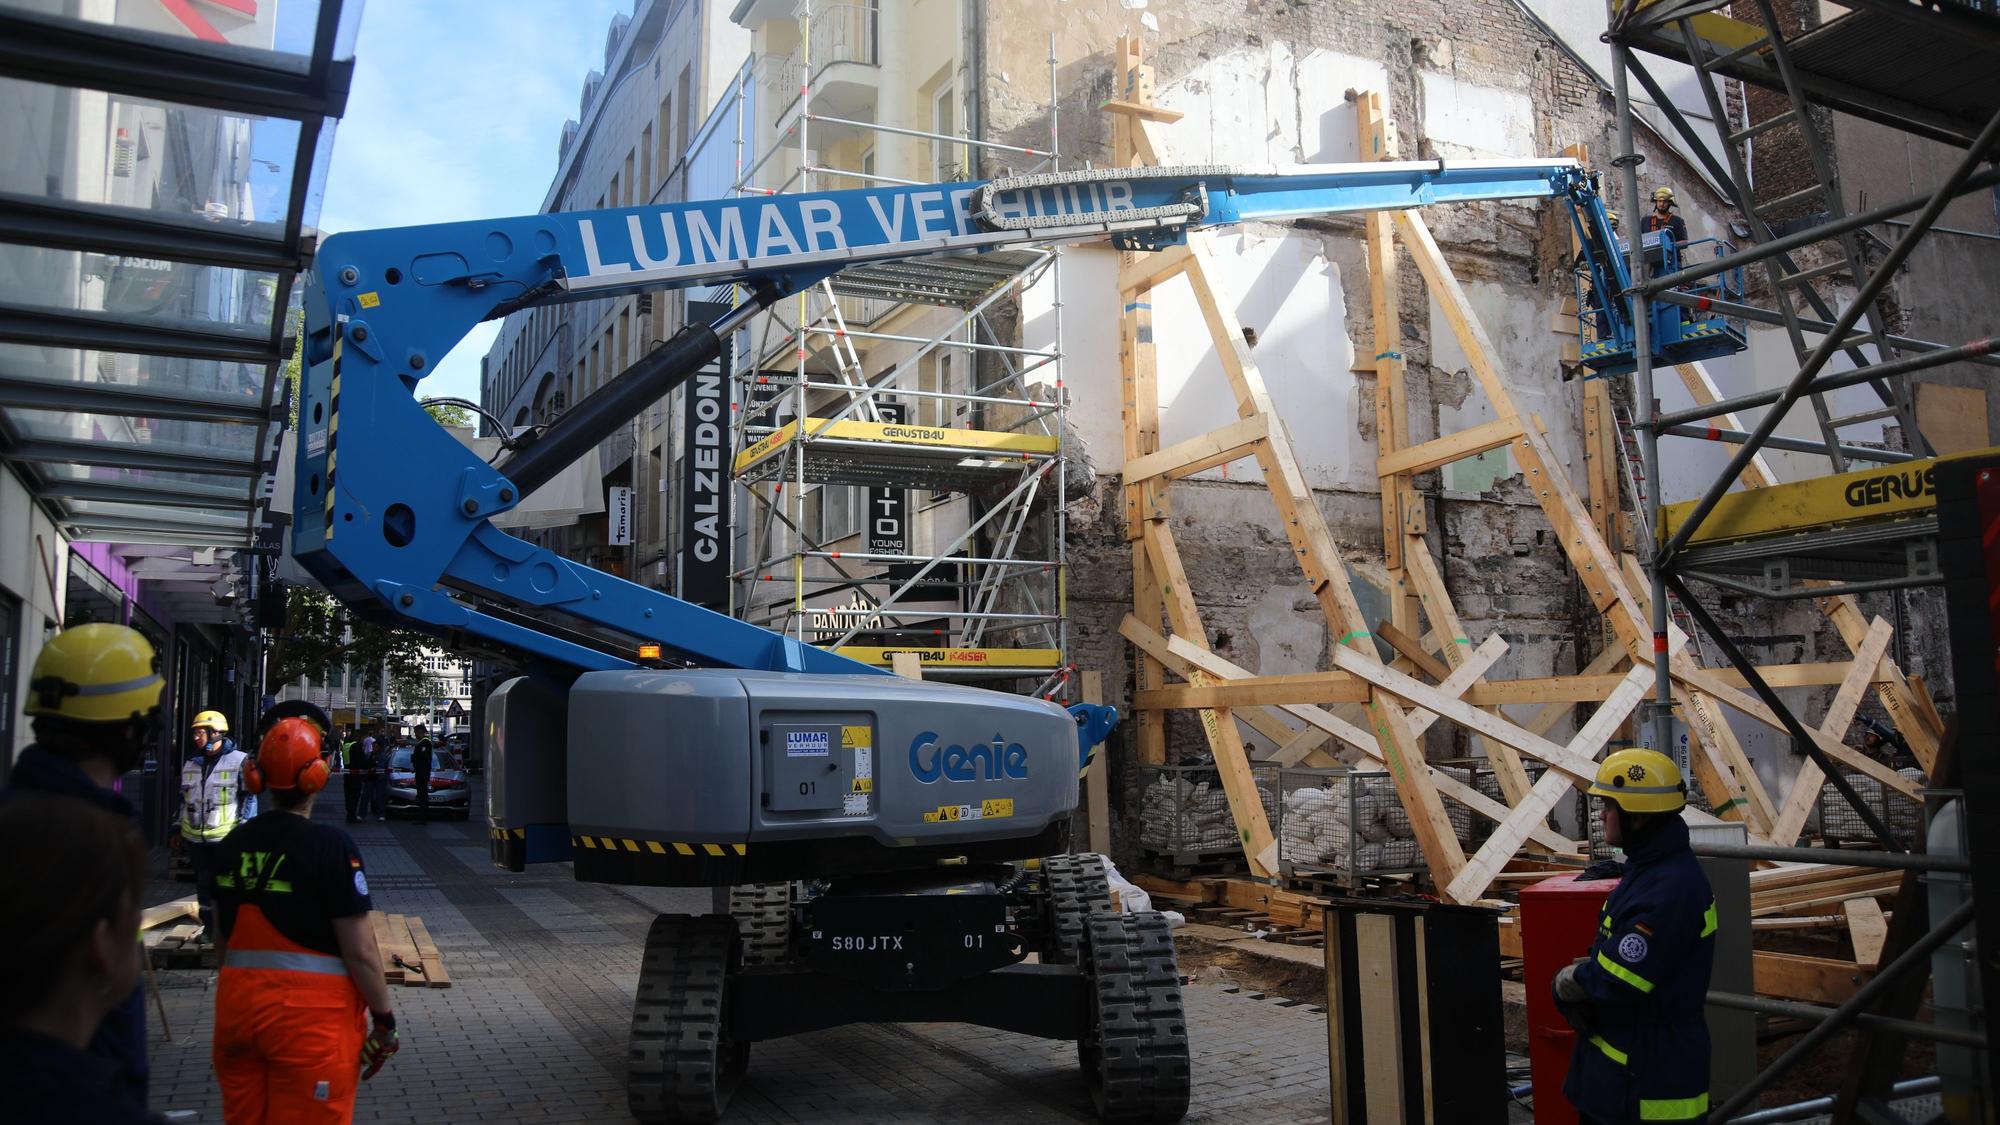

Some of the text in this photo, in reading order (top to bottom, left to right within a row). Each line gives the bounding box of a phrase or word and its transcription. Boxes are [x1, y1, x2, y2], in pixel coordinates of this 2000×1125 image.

[577, 200, 846, 274] LUMAR
[694, 356, 721, 563] CALZEDONI
[871, 539, 903, 548] YOUNG
[870, 548, 906, 556] FASHION
[949, 651, 987, 662] KAISER
[1690, 694, 1717, 739] SIEGBURG
[788, 733, 827, 743] LUMAR
[908, 731, 1029, 784] Genie
[1680, 745, 1688, 769] BG BAU
[799, 781, 816, 796] 01
[832, 935, 904, 951] S80JTX
[964, 933, 984, 949] 01
